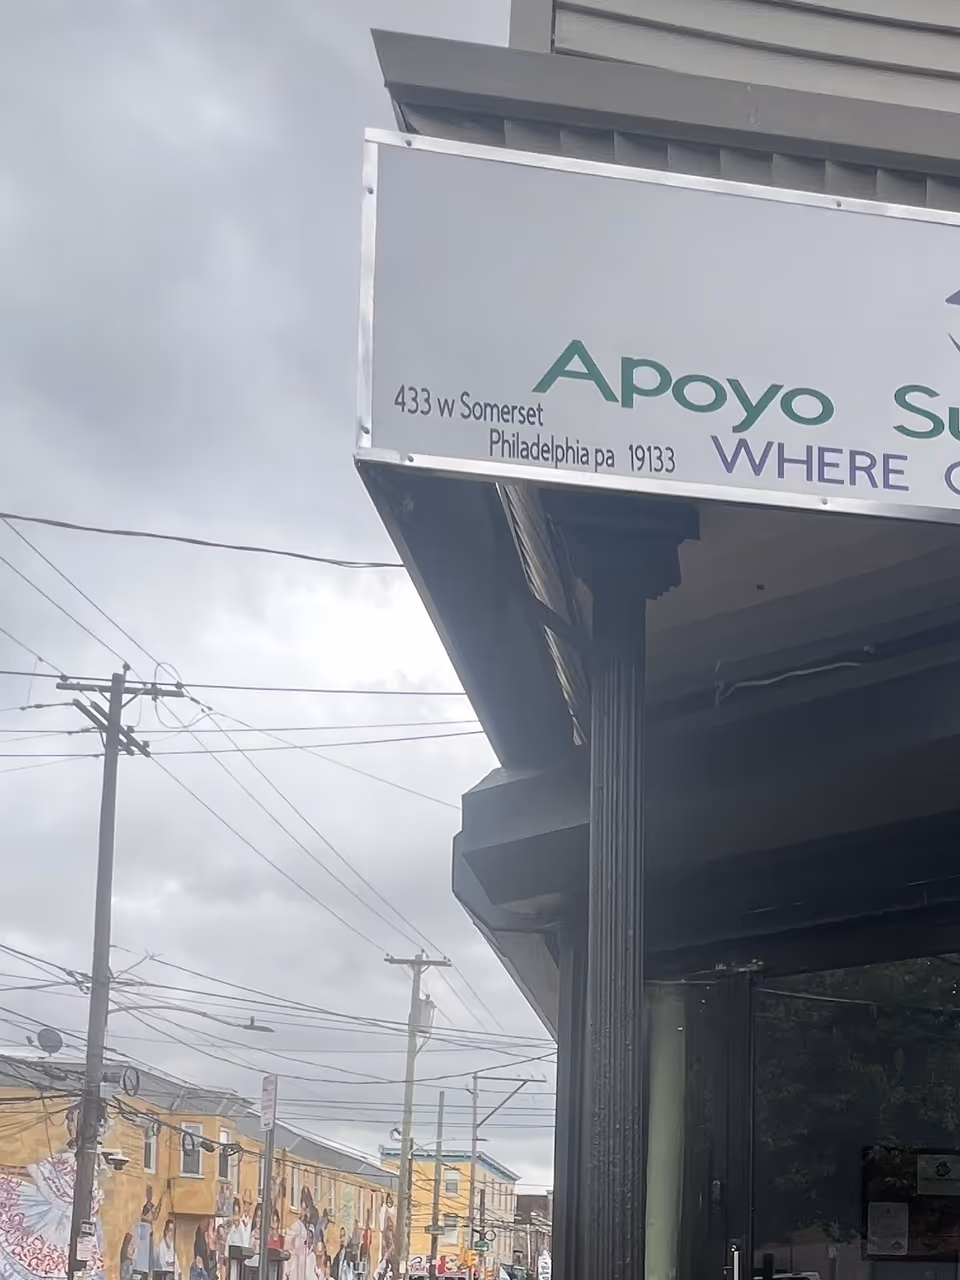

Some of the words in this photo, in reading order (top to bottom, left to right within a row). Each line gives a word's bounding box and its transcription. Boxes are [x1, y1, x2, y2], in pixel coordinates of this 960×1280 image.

[393, 384, 432, 416] 433
[460, 390, 544, 427] Somerset
[532, 339, 834, 434] Apoyo
[489, 427, 590, 469] Philadelphia
[594, 447, 615, 473] pa
[628, 443, 676, 474] 19133
[711, 434, 910, 492] WHERE
